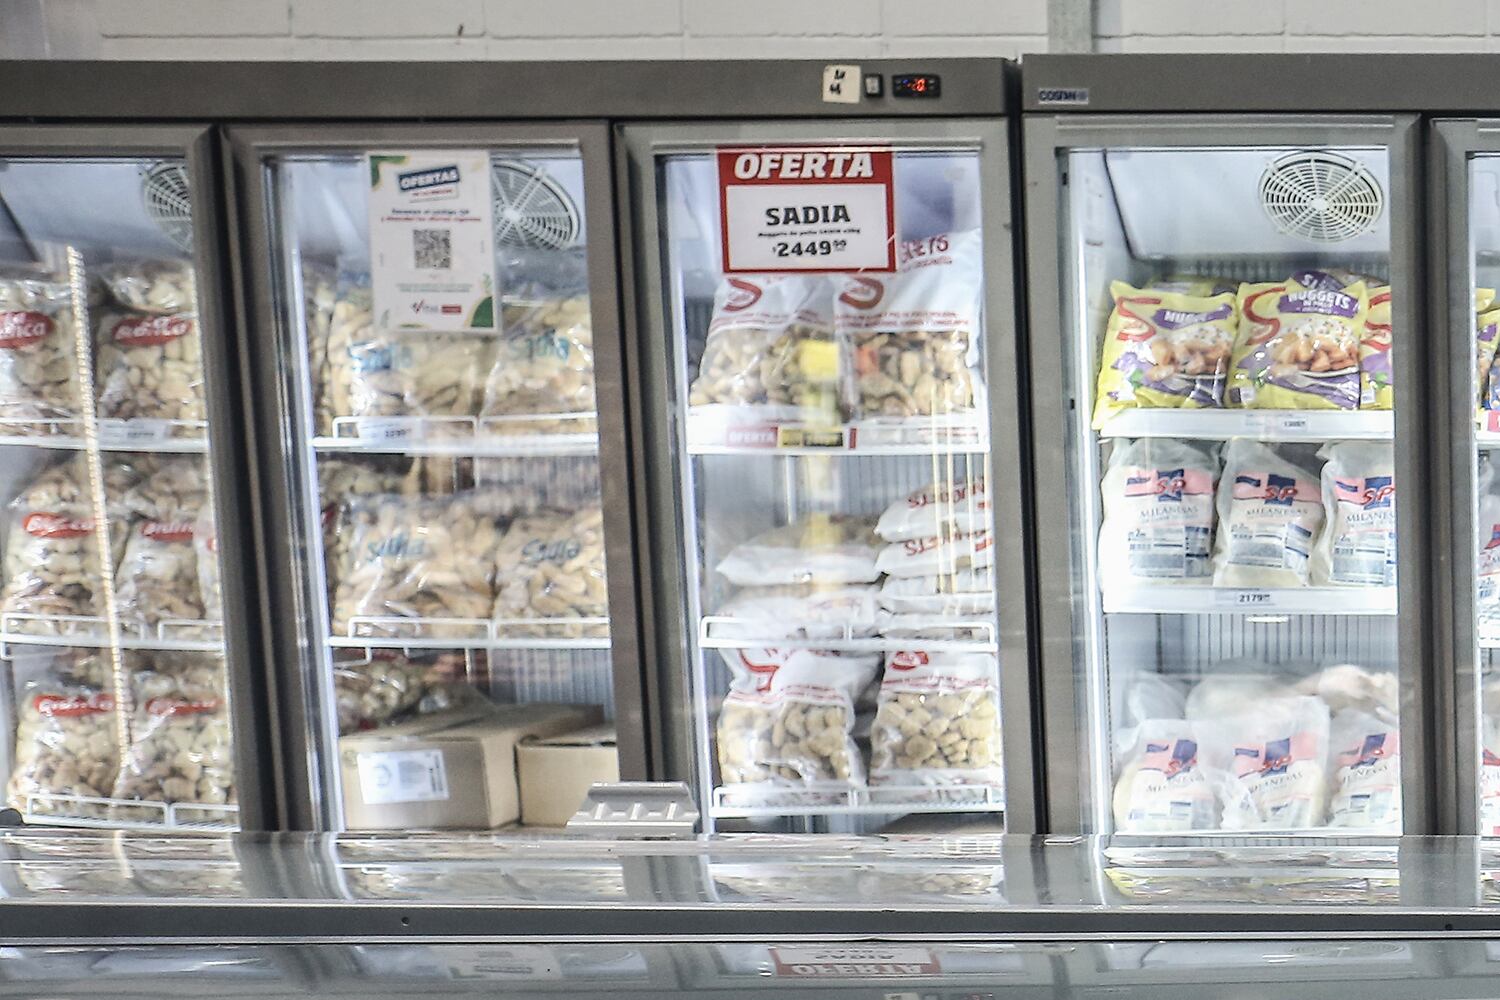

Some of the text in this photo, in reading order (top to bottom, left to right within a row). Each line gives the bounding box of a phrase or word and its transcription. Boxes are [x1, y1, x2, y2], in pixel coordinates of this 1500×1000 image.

[734, 152, 874, 180] OFERTA
[401, 169, 459, 190] OFERTAS
[766, 205, 851, 226] SADIA
[1288, 290, 1351, 309] NUGGETS
